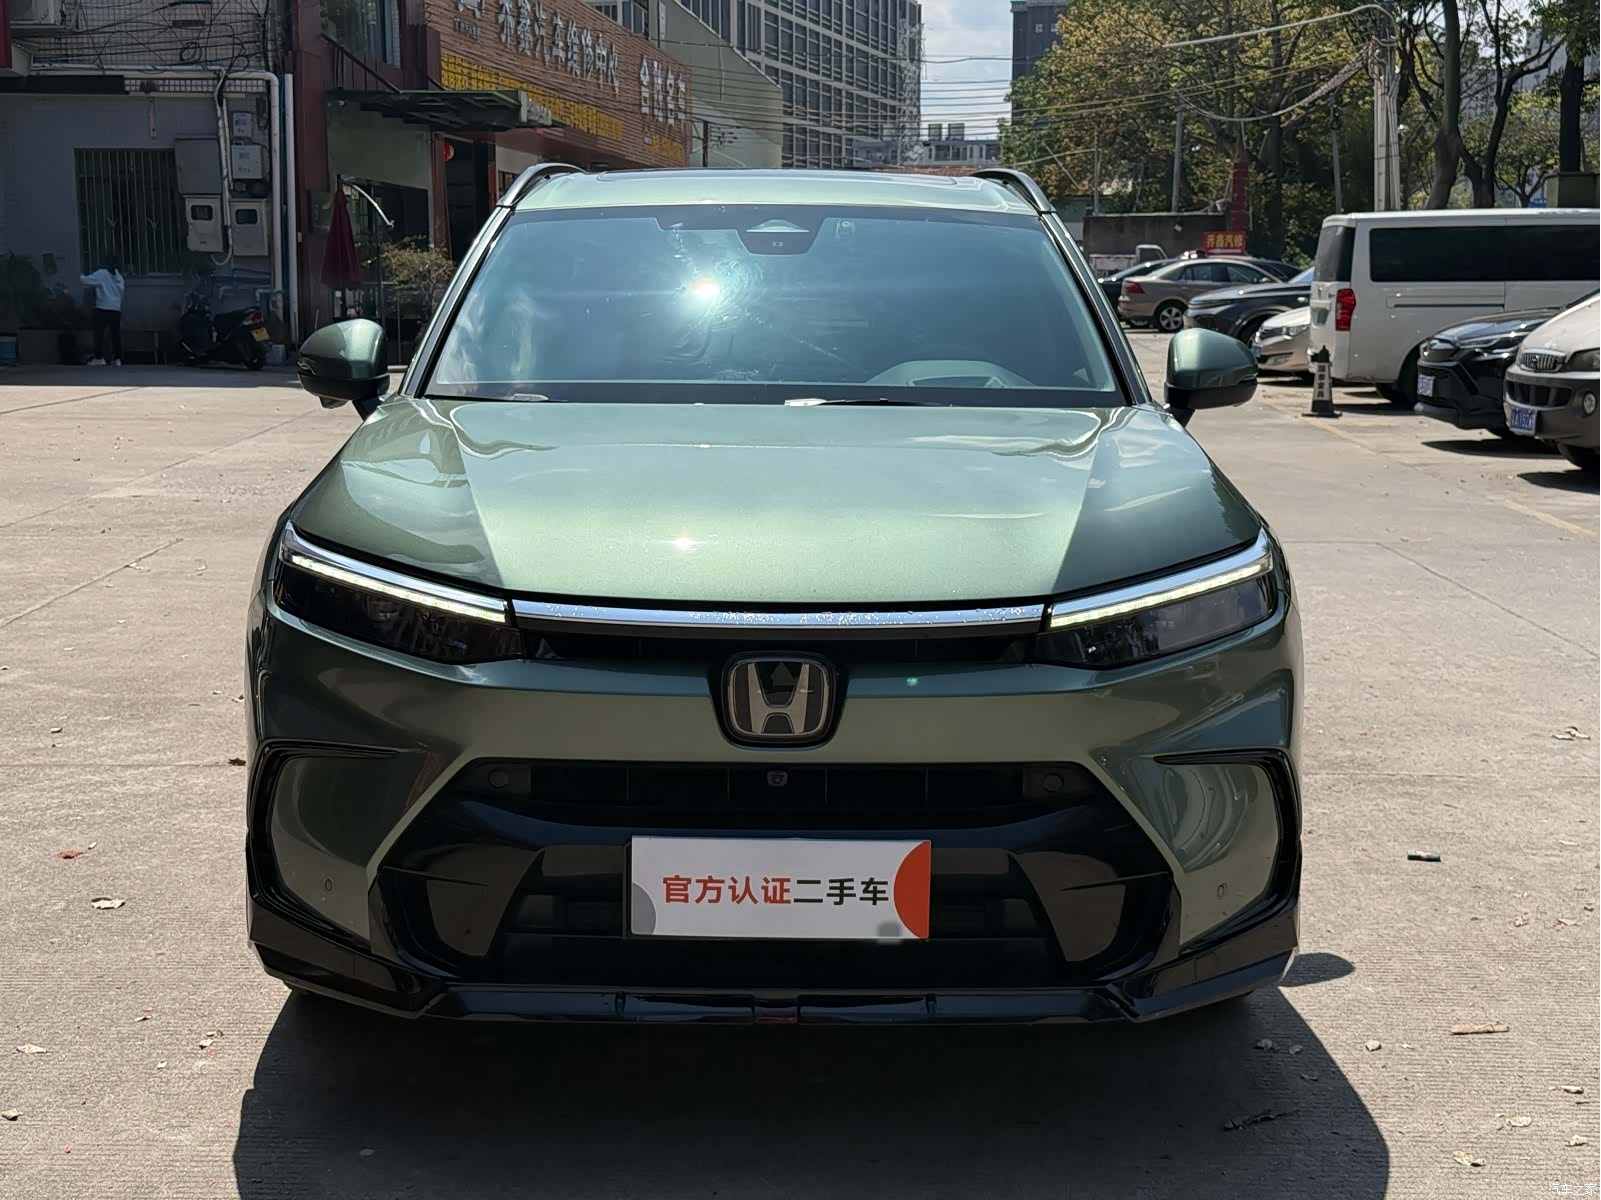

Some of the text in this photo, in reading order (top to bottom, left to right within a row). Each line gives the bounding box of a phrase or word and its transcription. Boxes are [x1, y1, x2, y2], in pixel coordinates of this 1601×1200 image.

[662, 875, 889, 905] 官方认证二手车
